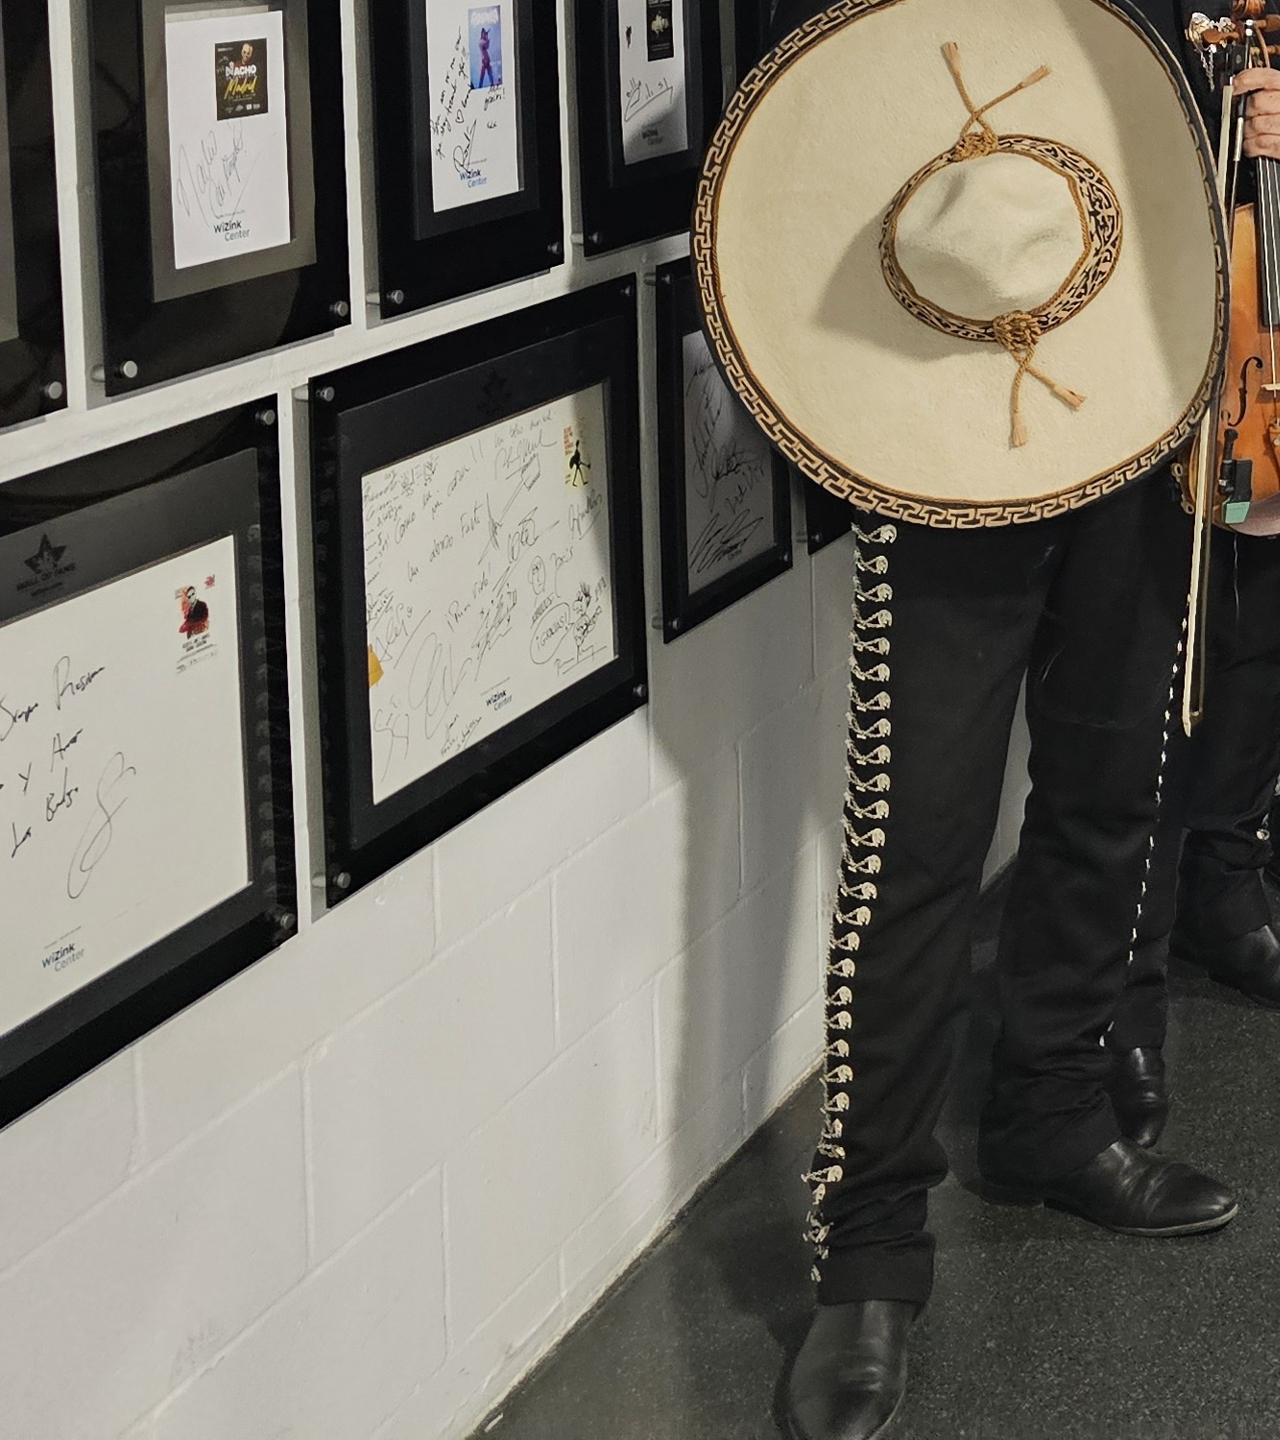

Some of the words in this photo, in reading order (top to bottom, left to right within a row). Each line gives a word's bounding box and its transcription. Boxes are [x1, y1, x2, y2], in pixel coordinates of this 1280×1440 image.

[225, 62, 257, 78] NACHO
[213, 220, 242, 234] WiZink
[41, 943, 75, 969] WiZink
